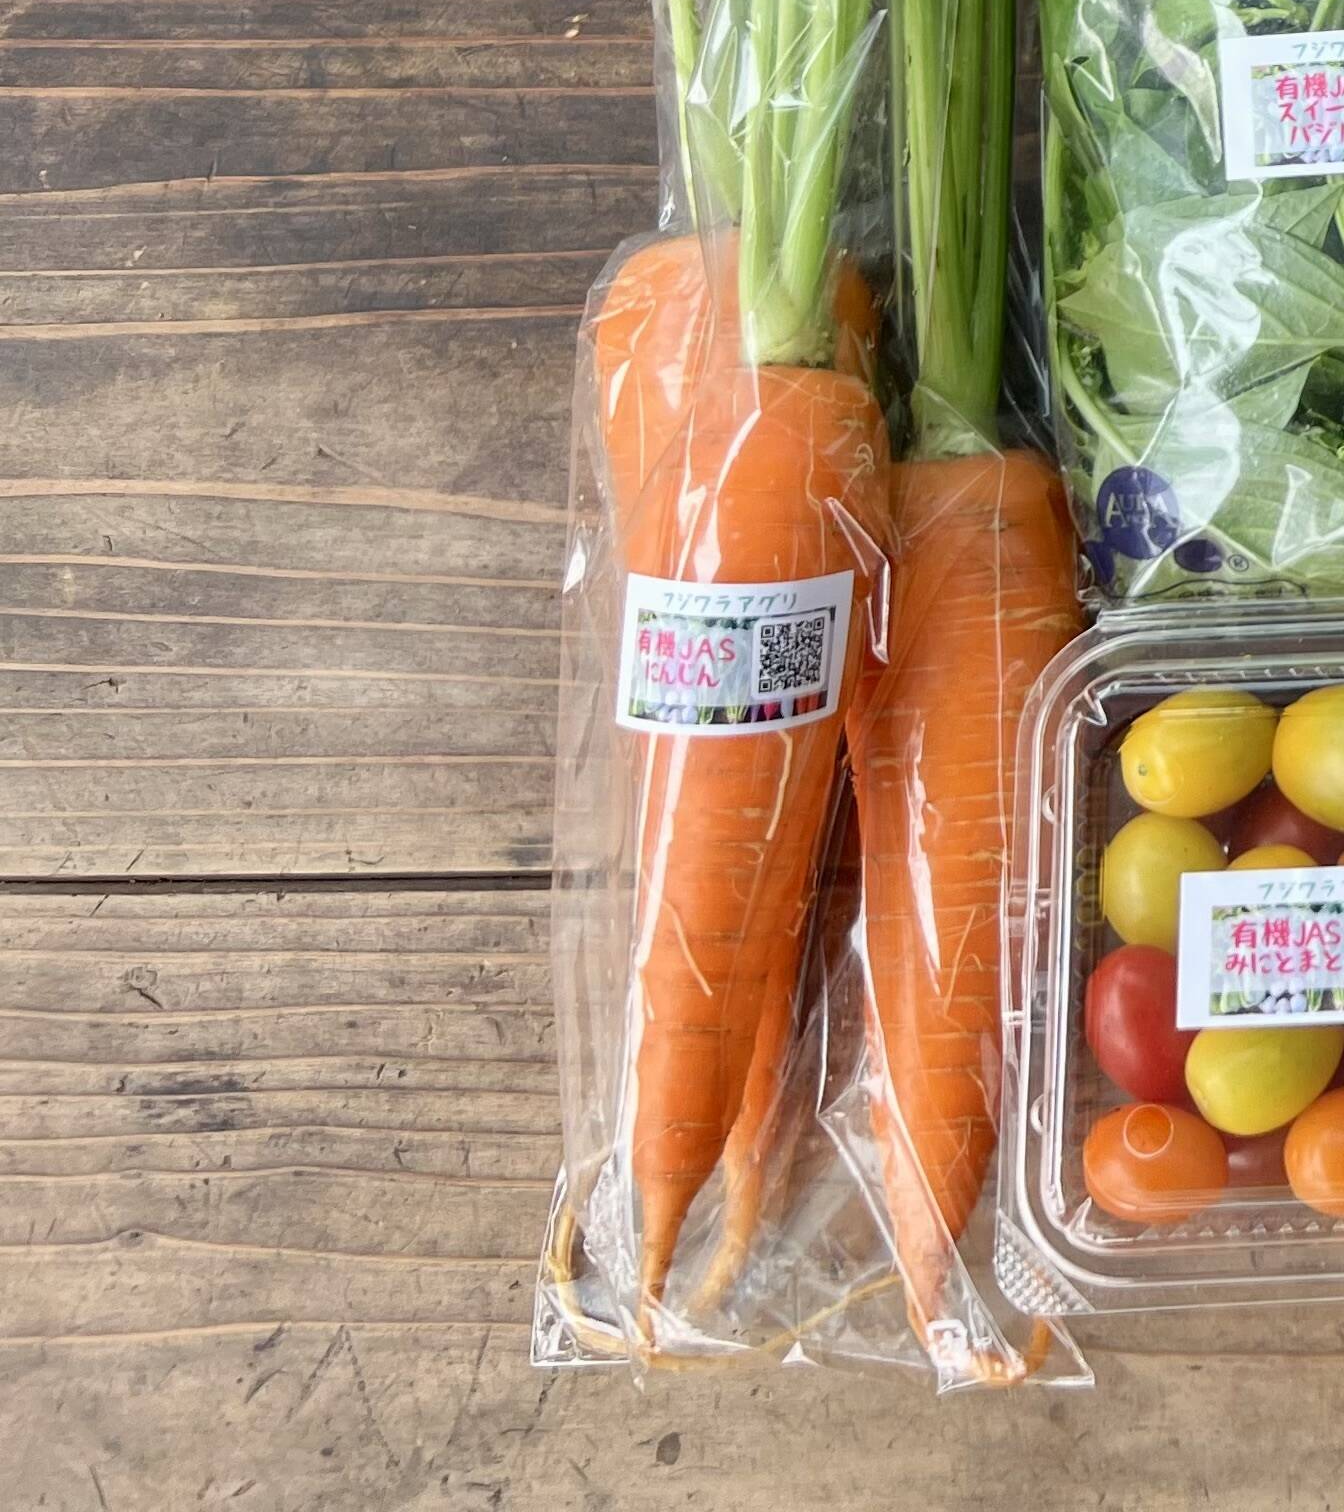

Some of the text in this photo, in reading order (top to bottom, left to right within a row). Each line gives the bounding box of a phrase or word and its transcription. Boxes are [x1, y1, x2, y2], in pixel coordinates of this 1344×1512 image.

[664, 592, 797, 612] フジワラアグリ
[639, 628, 736, 663] 有機JAS
[645, 659, 720, 687] にんじん
[1231, 920, 1342, 948] 有機JAS
[1225, 950, 1342, 974] みにとまと
